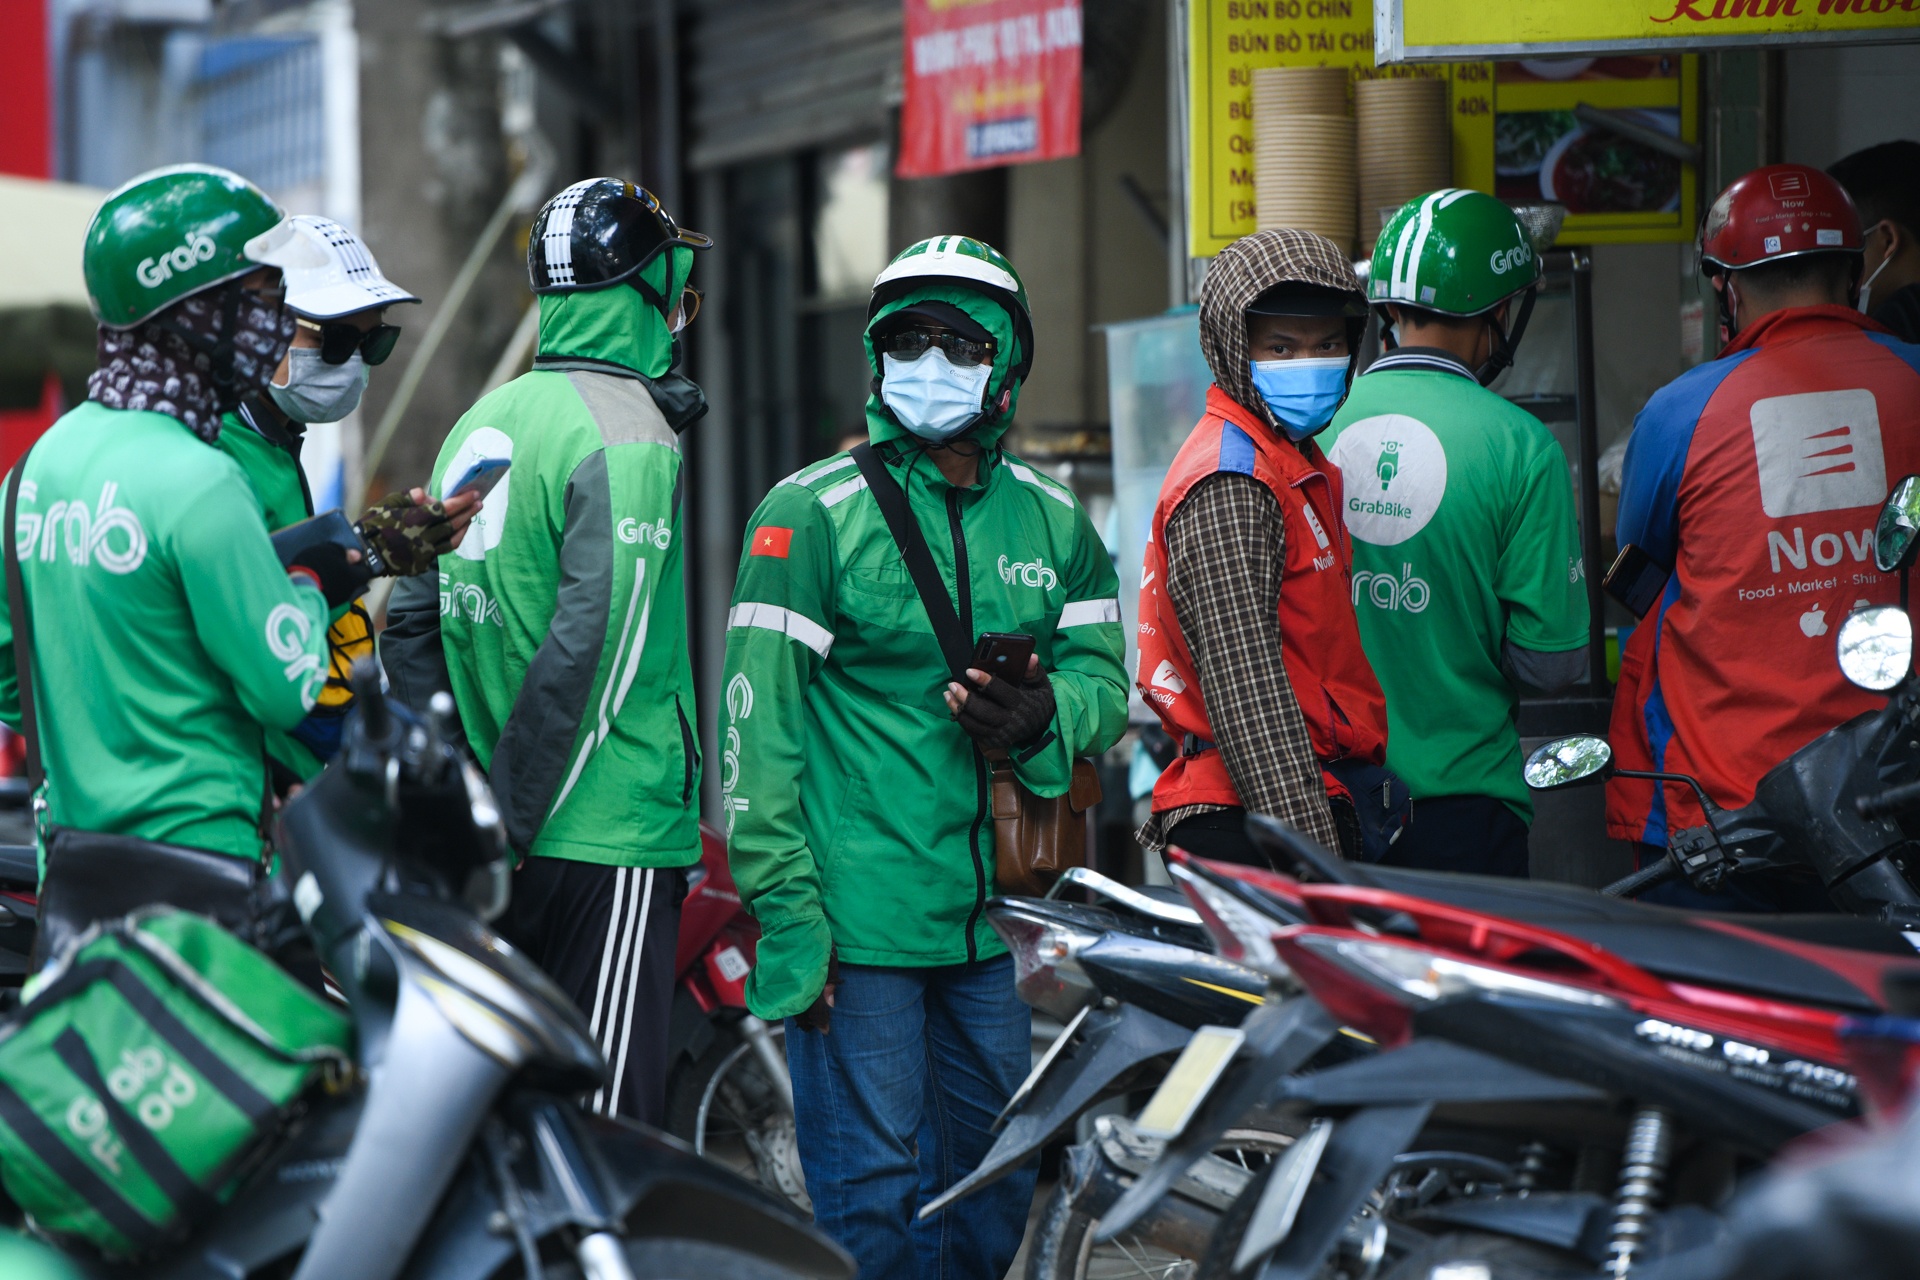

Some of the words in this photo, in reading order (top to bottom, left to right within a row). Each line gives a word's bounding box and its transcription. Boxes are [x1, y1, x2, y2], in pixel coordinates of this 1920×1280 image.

[1228, 28, 1269, 53] BÚN
[1275, 28, 1302, 53] BÒ
[1306, 28, 1336, 53] TÁI
[1340, 25, 1375, 53] CHÍ
[1457, 96, 1489, 116] 40k
[1782, 200, 1804, 209] Now
[136, 231, 216, 289] Grab
[1490, 242, 1532, 275] Grab
[1349, 497, 1412, 519] GrabBike
[617, 517, 672, 551] Grab
[998, 554, 1057, 592] Grab
[1351, 562, 1431, 614] rab
[1738, 585, 1776, 602] Food
[1788, 577, 1838, 595] Market
[1150, 688, 1177, 710] Foody
[721, 671, 754, 840] Grab
